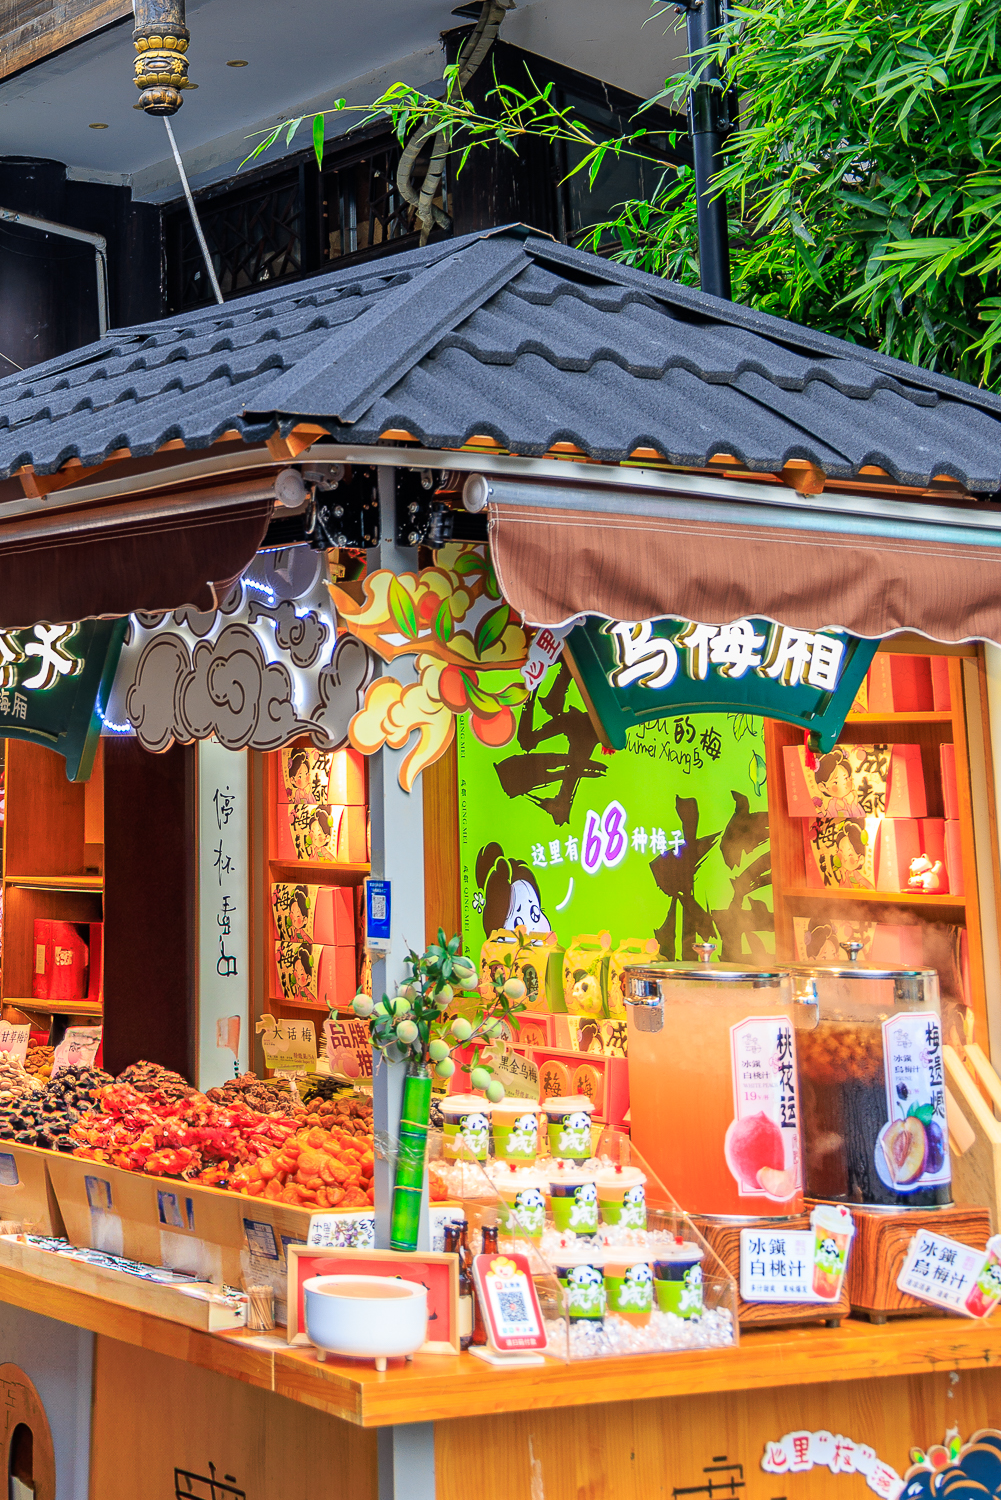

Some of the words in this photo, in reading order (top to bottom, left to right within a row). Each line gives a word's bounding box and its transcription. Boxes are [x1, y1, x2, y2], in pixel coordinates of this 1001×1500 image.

[674, 716, 696, 744] 的
[700, 726, 722, 761] 梅
[272, 1026, 312, 1042] 大话梅
[329, 1023, 373, 1049] 品牌
[498, 1055, 538, 1084] 黑金乌梅
[776, 1026, 797, 1128] 桃花运
[750, 1259, 806, 1278] 白桃汁
[911, 1259, 967, 1289] 烏梅汁
[505, 1338, 537, 1347] 请扫码付款
